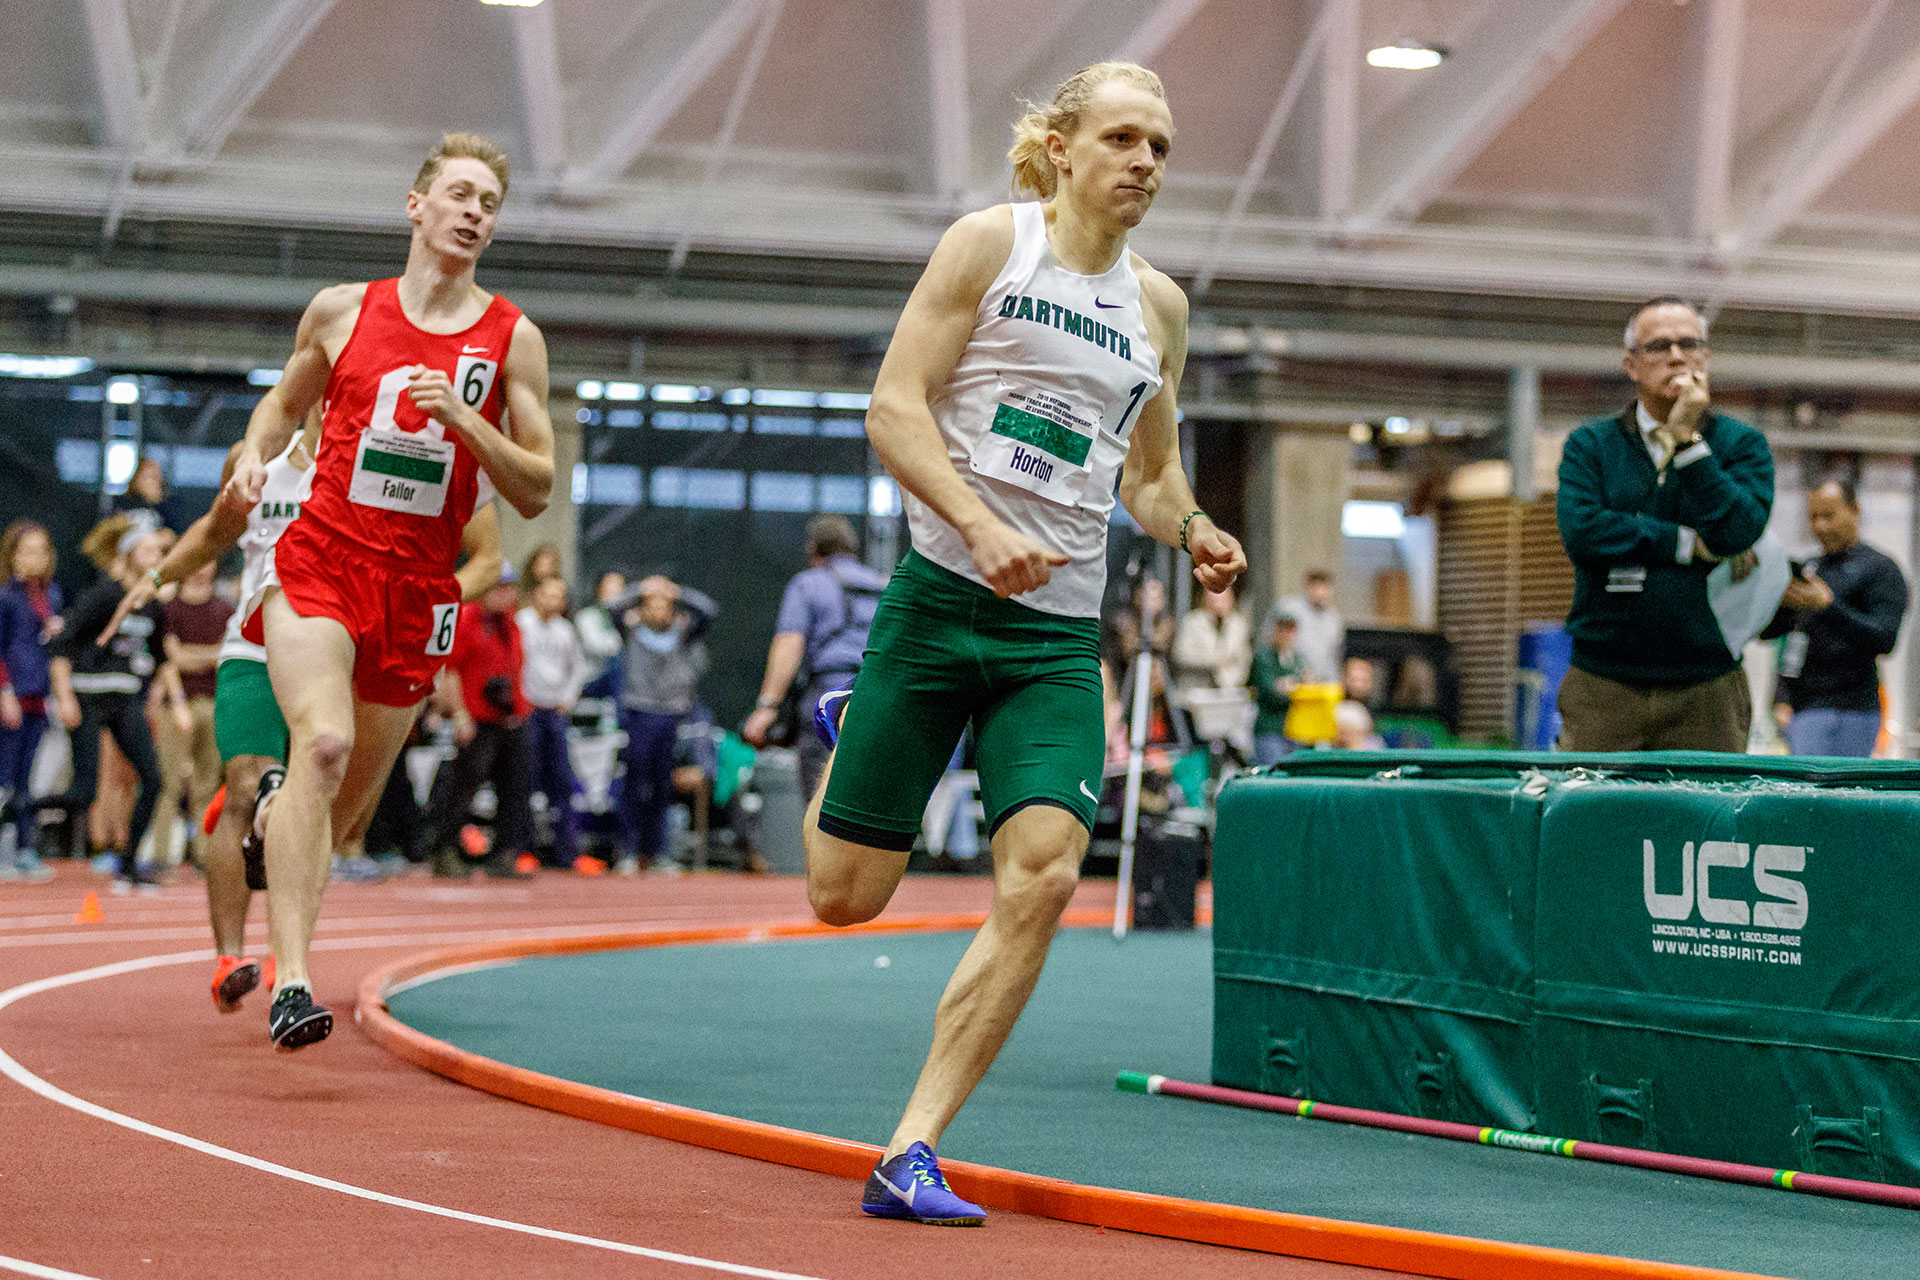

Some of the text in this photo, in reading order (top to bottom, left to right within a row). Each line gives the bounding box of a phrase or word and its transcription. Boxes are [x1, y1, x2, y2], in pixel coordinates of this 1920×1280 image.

[999, 294, 1132, 362] DARTMOUTH
[462, 362, 488, 406] 6
[1026, 397, 1042, 407] TRACK
[1115, 381, 1148, 435] 1
[1010, 446, 1054, 483] Horton
[437, 607, 454, 652] 6
[1643, 839, 1809, 930] UCS
[1652, 939, 1802, 966] WWW.UCSSPIRIT.COM
